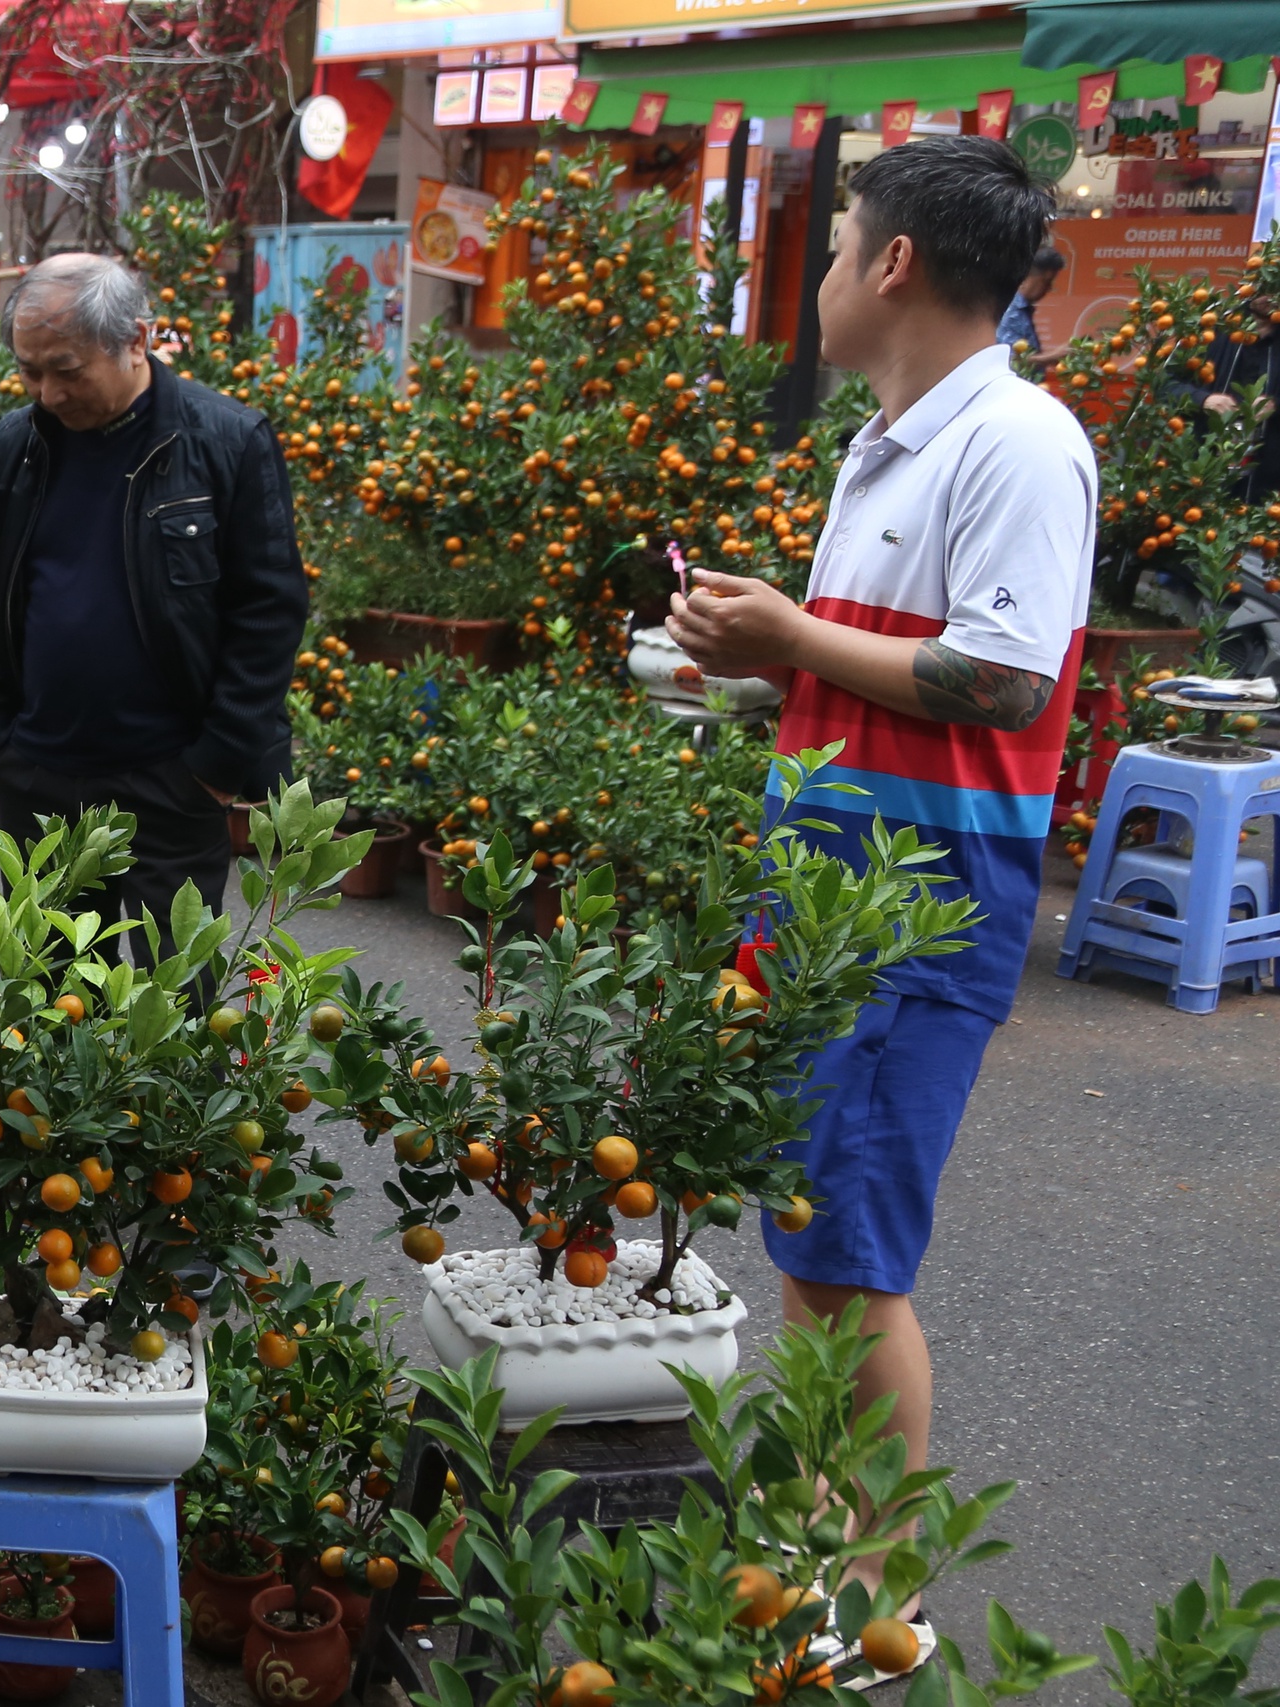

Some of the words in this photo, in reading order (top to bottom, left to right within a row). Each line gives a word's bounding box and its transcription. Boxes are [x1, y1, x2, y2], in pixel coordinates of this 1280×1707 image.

[1161, 190, 1233, 209] DRINKS
[1093, 246, 1147, 259] KITCHEN
[1188, 246, 1204, 258] MI
